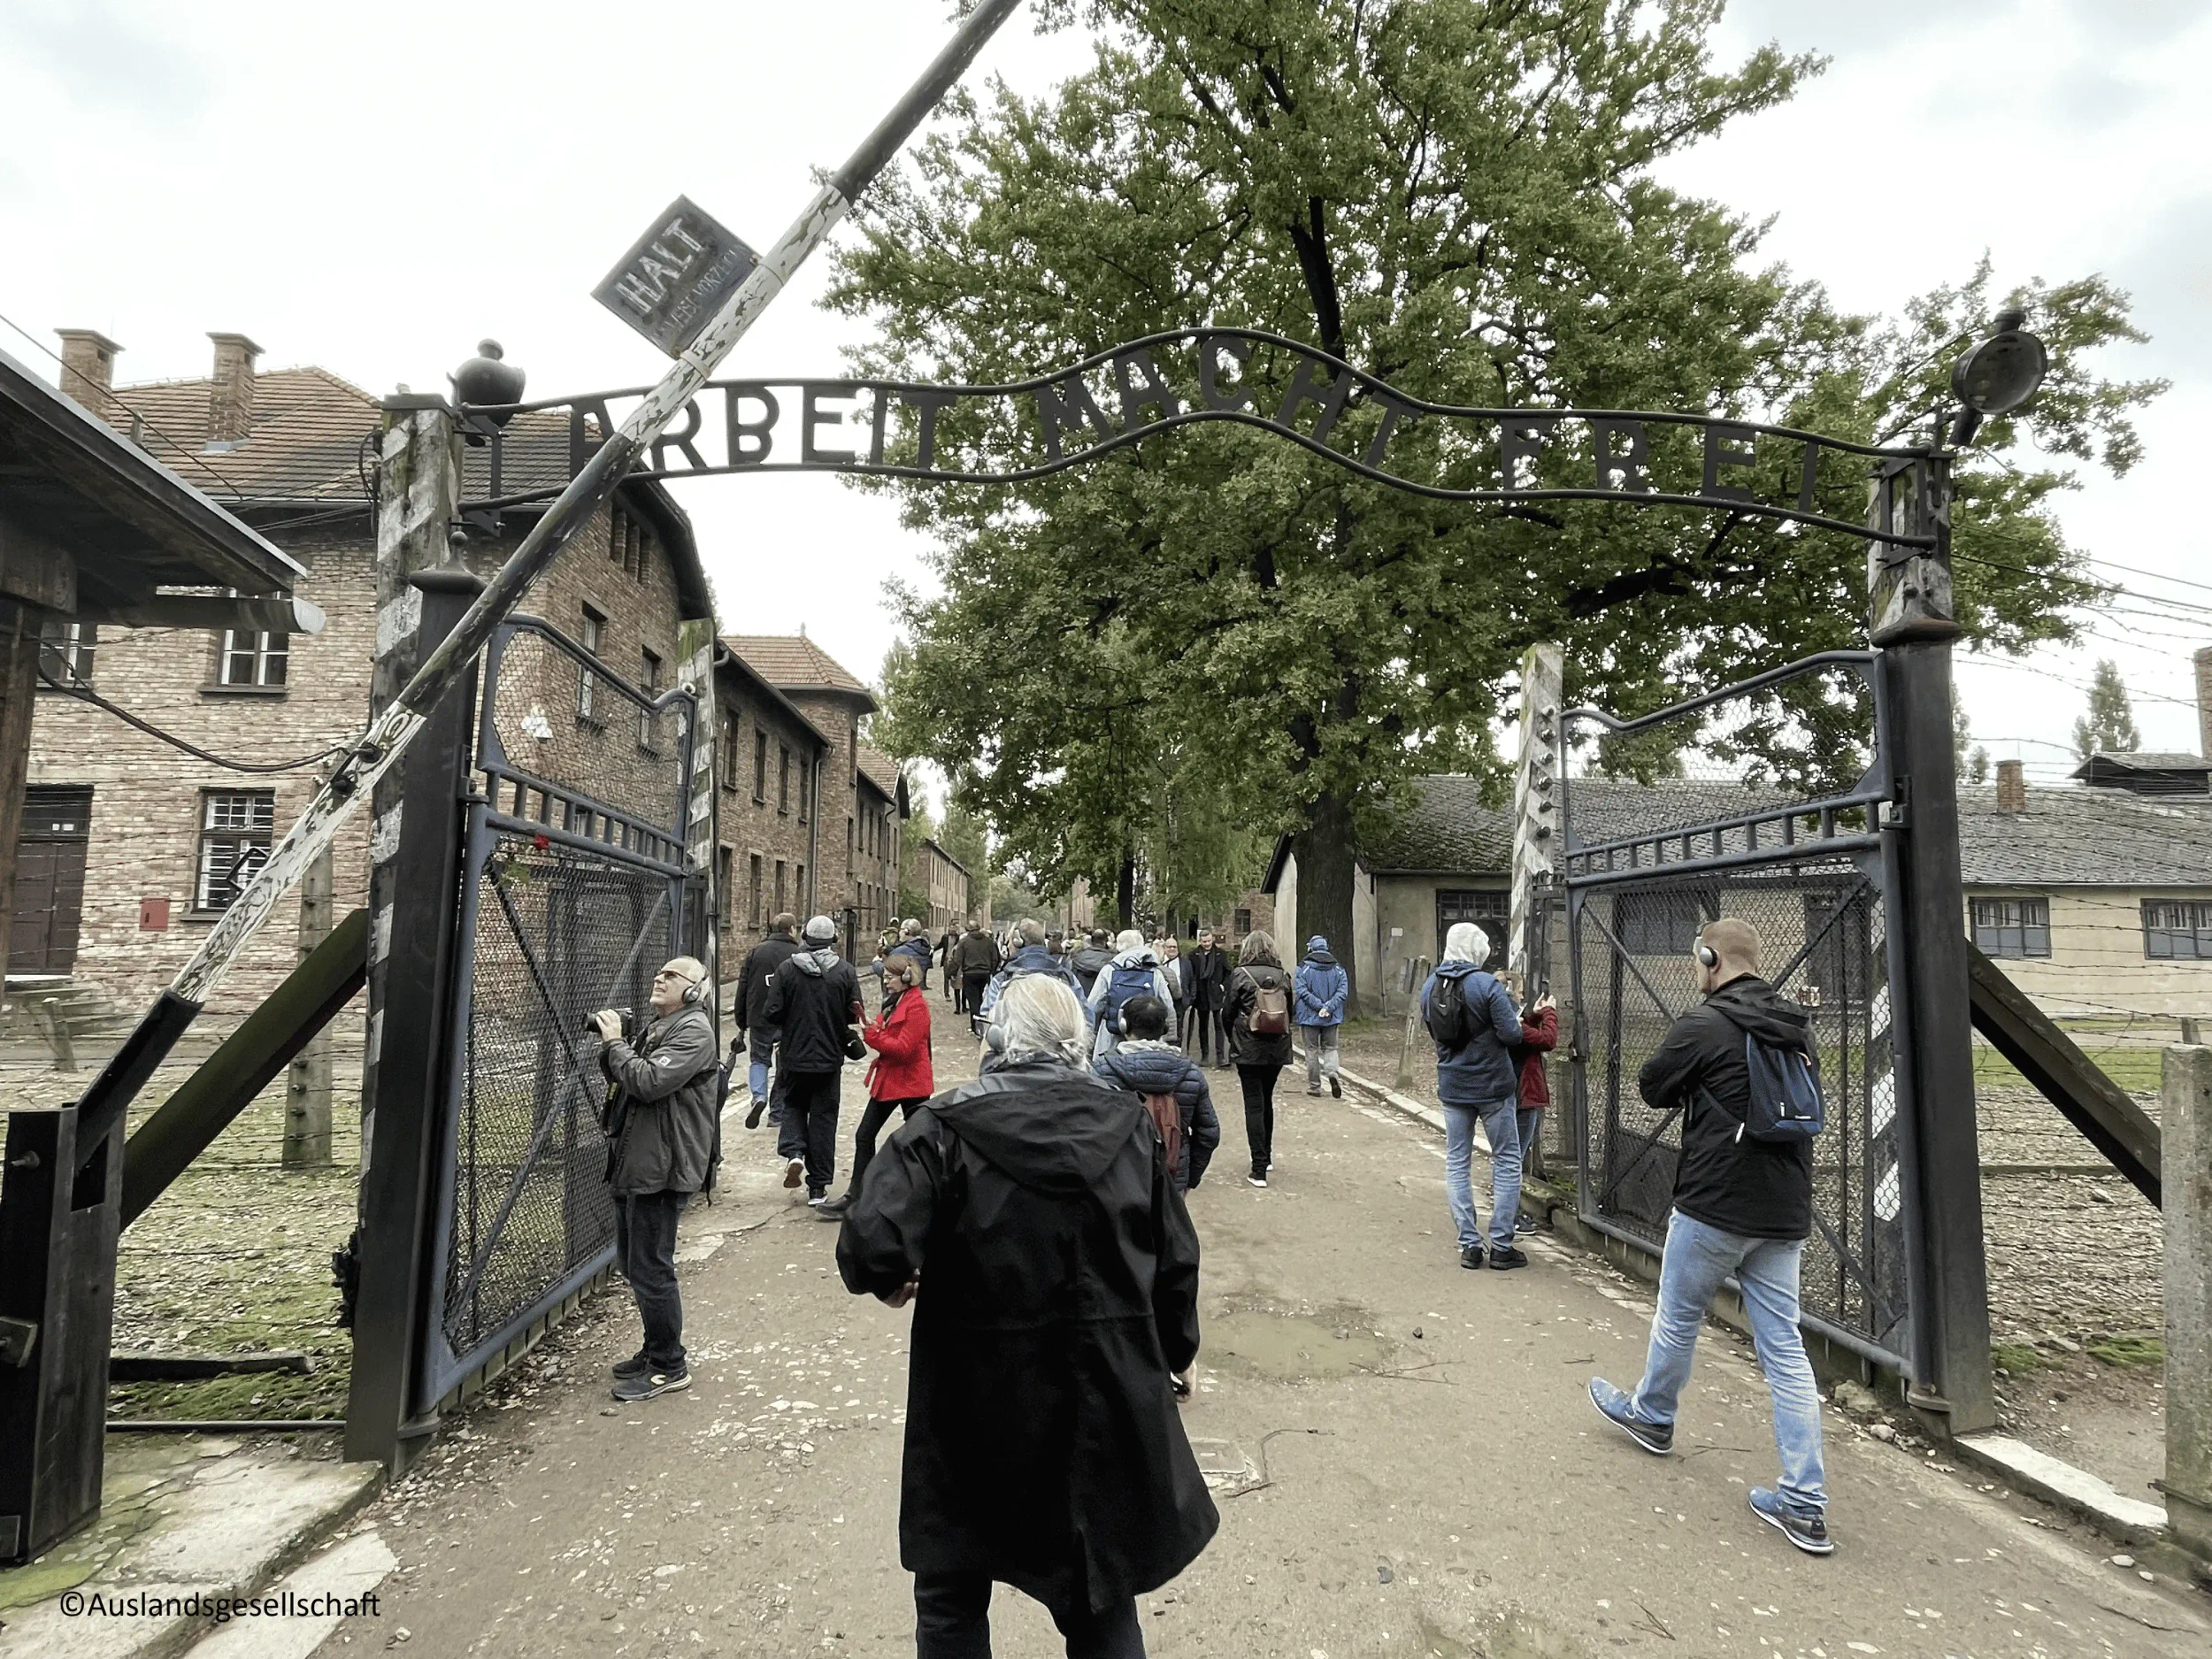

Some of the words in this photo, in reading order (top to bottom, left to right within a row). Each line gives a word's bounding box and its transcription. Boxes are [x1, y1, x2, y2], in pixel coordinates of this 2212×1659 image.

[616, 218, 703, 312] HALT
[570, 385, 956, 480] ARBEIT
[1037, 336, 1421, 469] MACHT
[1502, 418, 1819, 511] FREI
